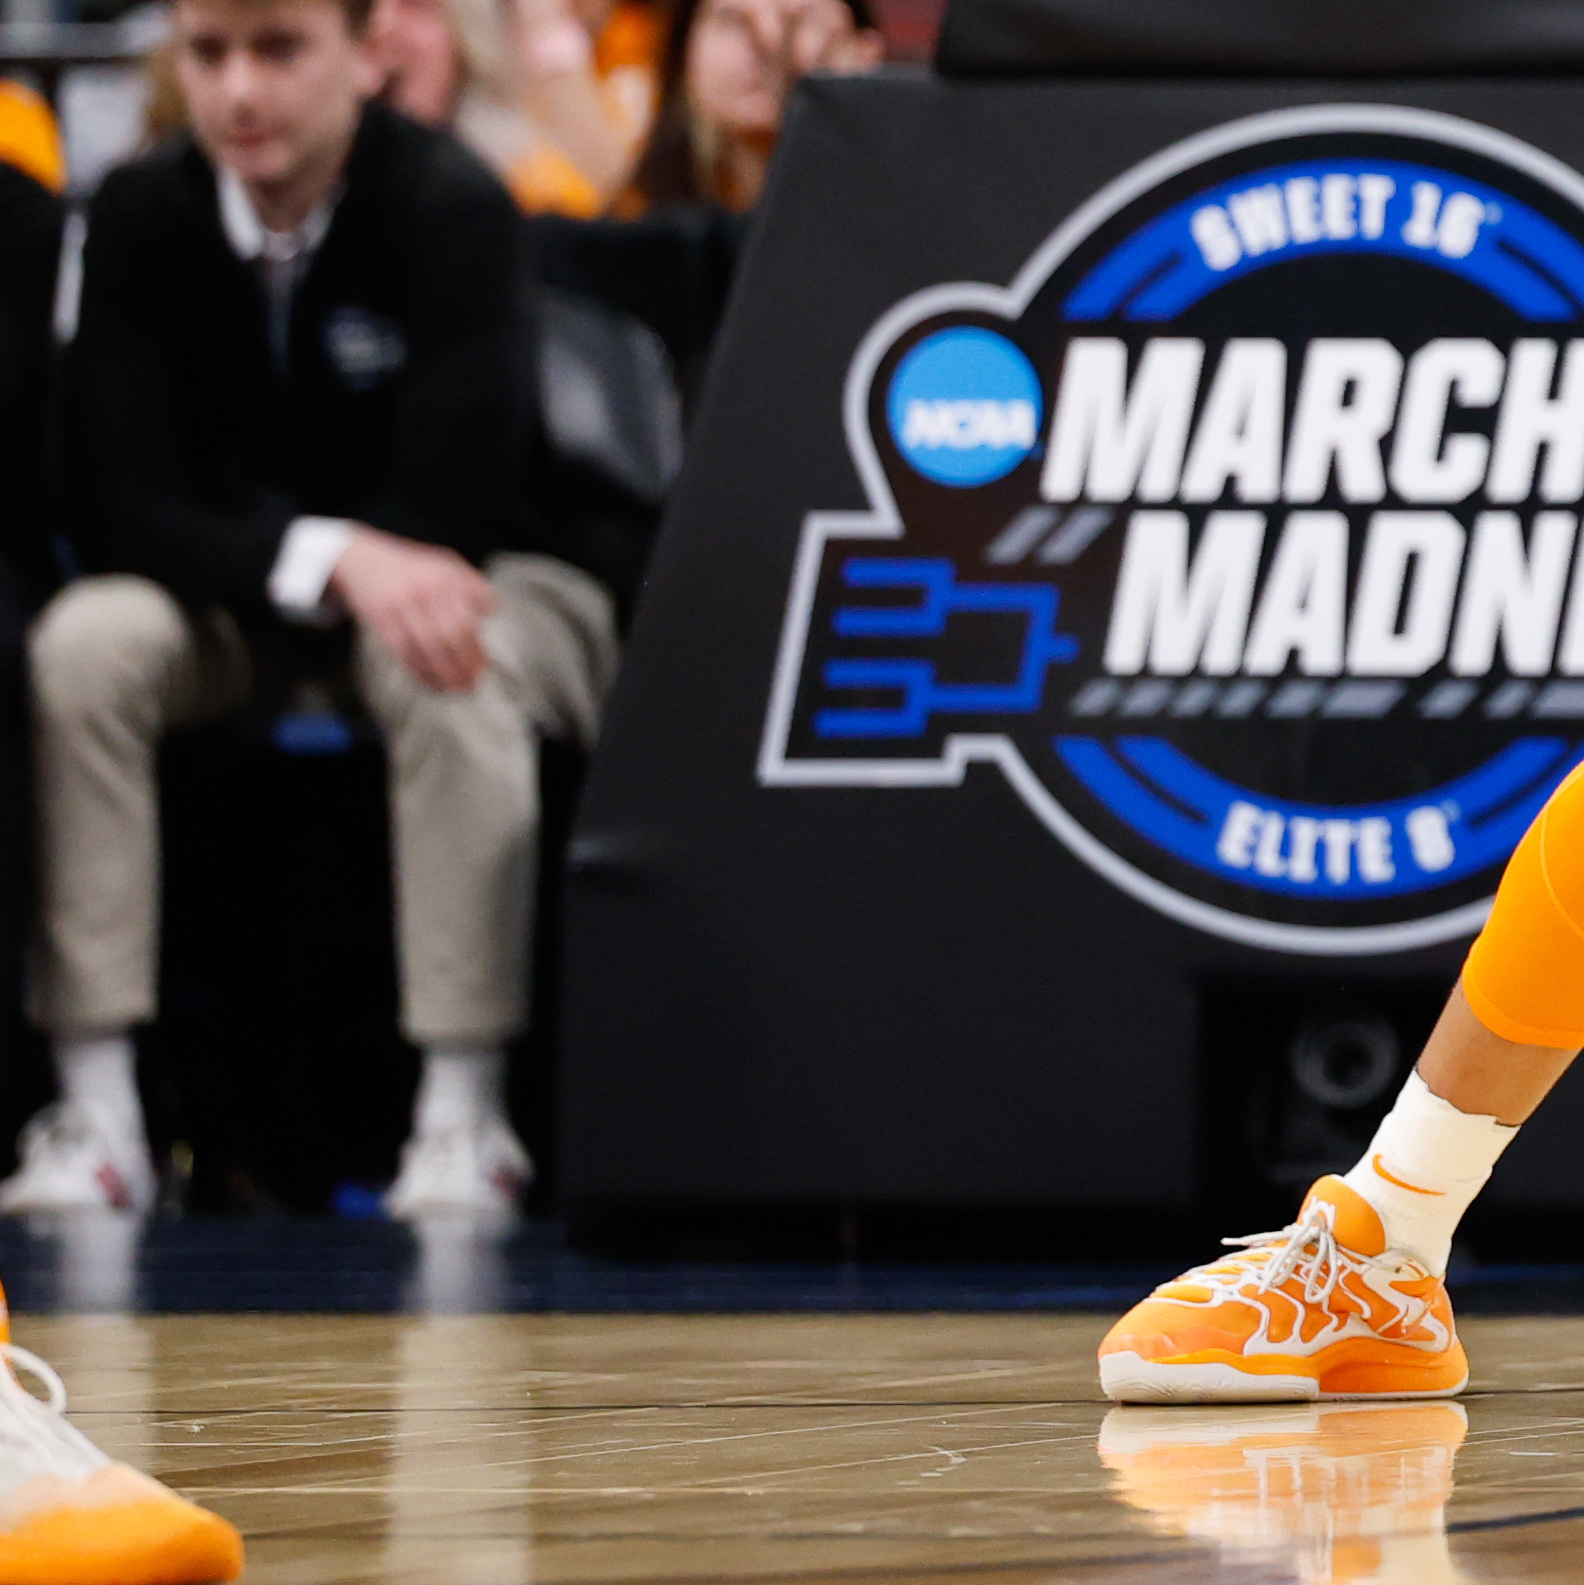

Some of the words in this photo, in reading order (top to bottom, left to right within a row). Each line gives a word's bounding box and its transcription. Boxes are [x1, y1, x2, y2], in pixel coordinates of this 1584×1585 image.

[1190, 173, 1397, 272] SWEET
[1401, 180, 1487, 260] 16
[902, 398, 1037, 451] NCAA
[1217, 800, 1397, 886] ELITE
[1404, 805, 1456, 873] 8
